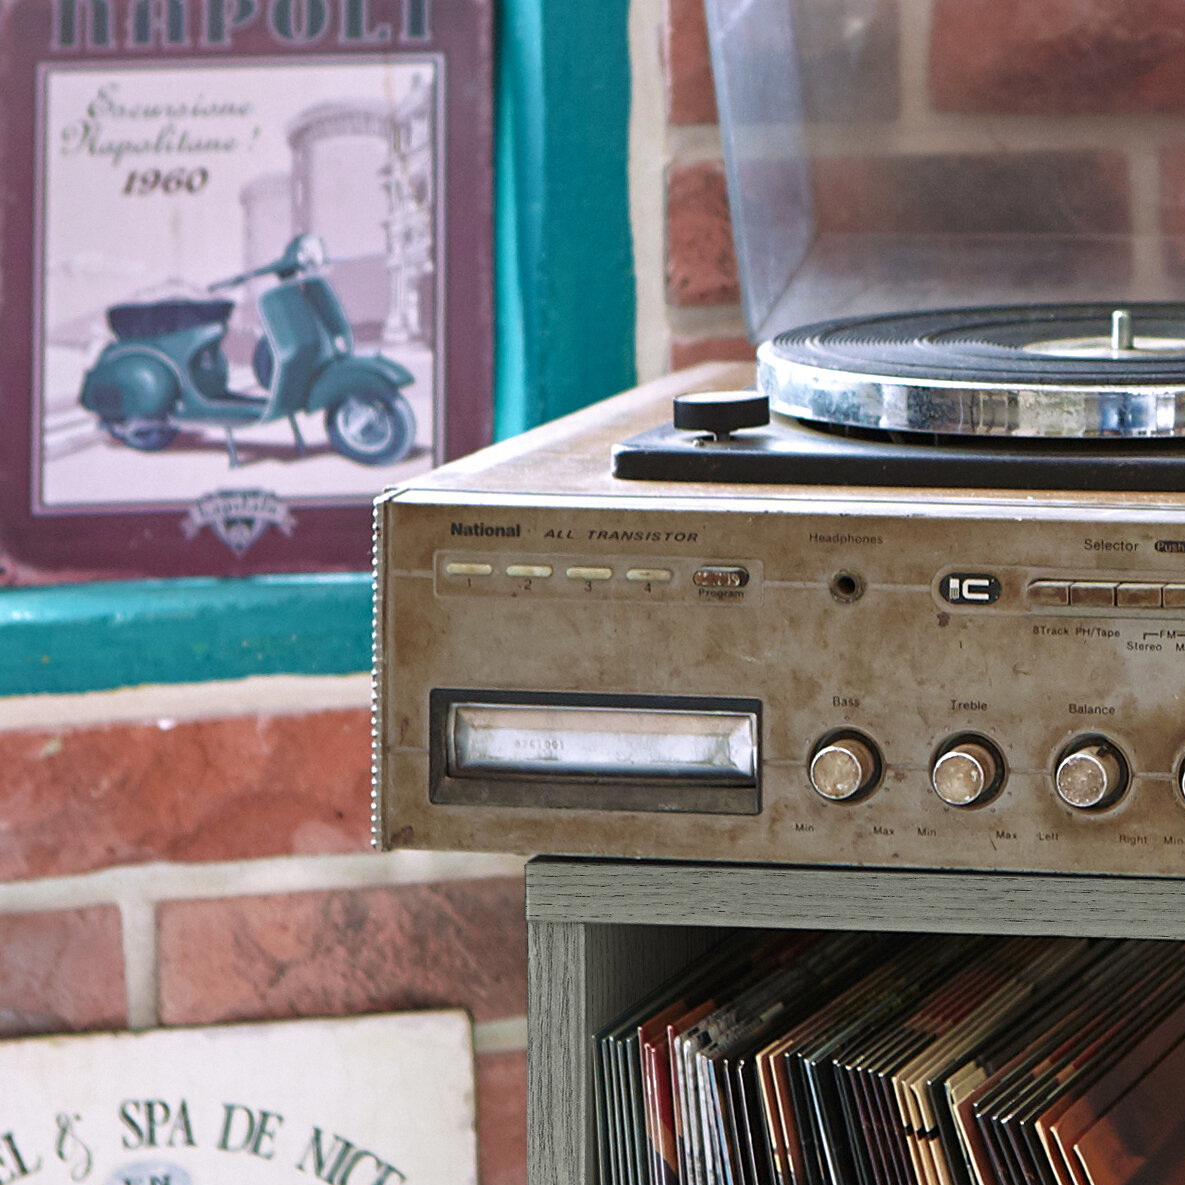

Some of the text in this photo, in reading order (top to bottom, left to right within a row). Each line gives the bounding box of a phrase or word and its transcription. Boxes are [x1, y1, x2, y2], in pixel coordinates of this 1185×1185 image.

[122, 165, 210, 197] 1960
[451, 522, 521, 538] National
[544, 529, 699, 542] ALL TRANSISTOR
[809, 533, 884, 545] Headphones
[1084, 539, 1139, 551] Selector
[524, 579, 532, 591] 2
[584, 581, 592, 592] 3
[644, 583, 651, 593] 4
[699, 588, 744, 600] Program
[1075, 627, 1120, 638] PH/Tape
[1159, 632, 1177, 640] FM
[1127, 641, 1162, 652] Stereo
[832, 696, 860, 708] Bass
[950, 700, 988, 711] Treble
[1068, 703, 1116, 716] Balance
[795, 823, 815, 832] Min
[873, 826, 895, 836] Max
[917, 827, 937, 836] Min
[996, 831, 1017, 840] Max
[1039, 832, 1059, 841] Left
[1119, 834, 1148, 846] Right
[1163, 836, 1183, 845] Min
[119, 1098, 197, 1150] SPA
[217, 1102, 284, 1160] DE
